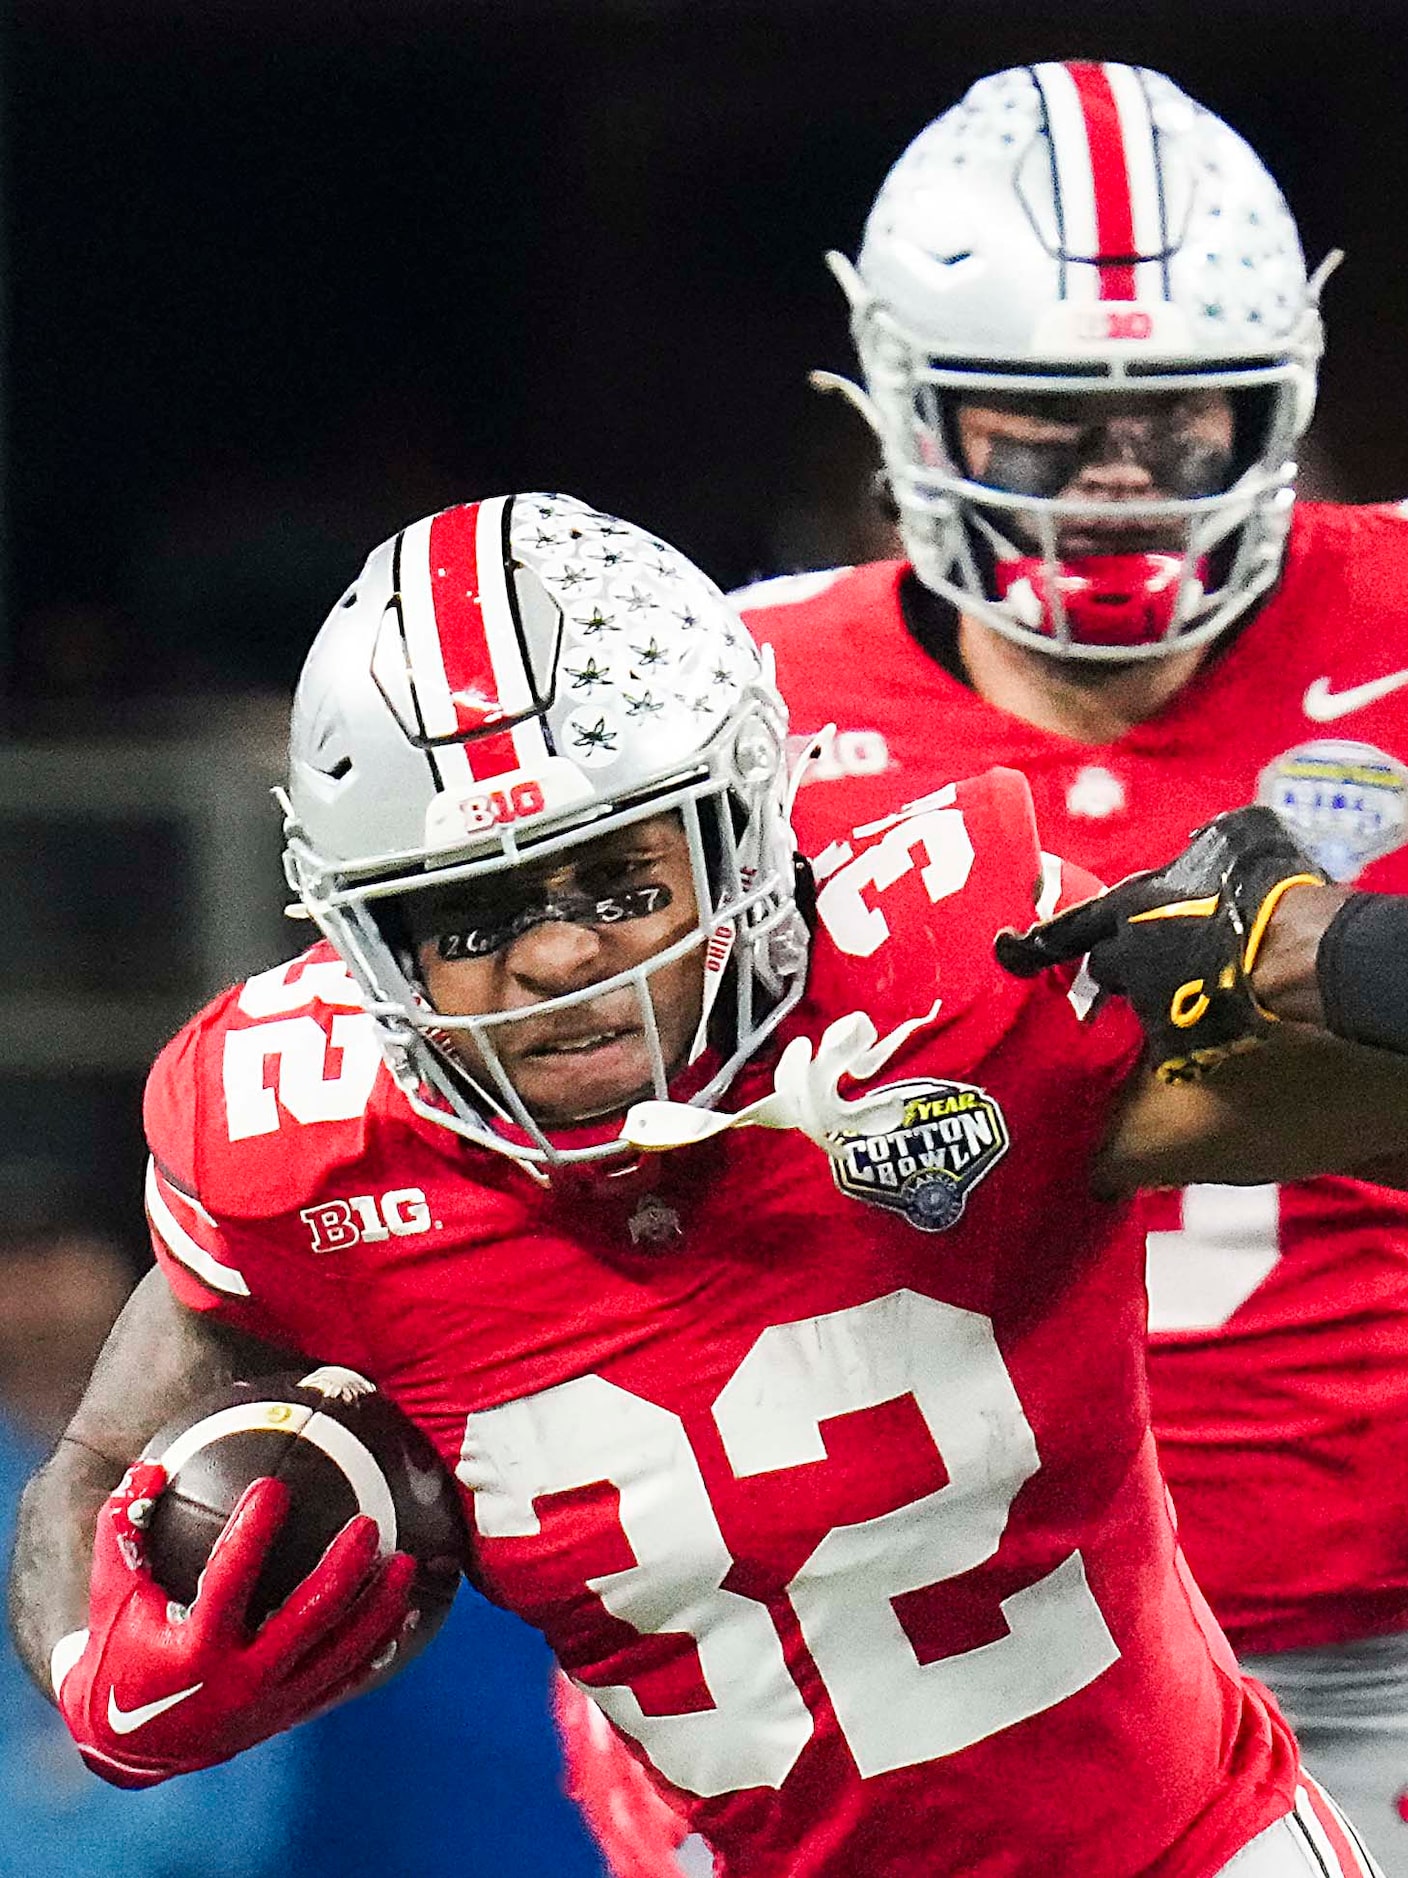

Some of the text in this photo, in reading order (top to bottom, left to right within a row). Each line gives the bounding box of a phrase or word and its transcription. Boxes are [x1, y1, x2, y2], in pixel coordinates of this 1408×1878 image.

[844, 1110, 994, 1182] COTTON
[876, 1143, 972, 1188] BOWL
[454, 1288, 1122, 1798] 32
